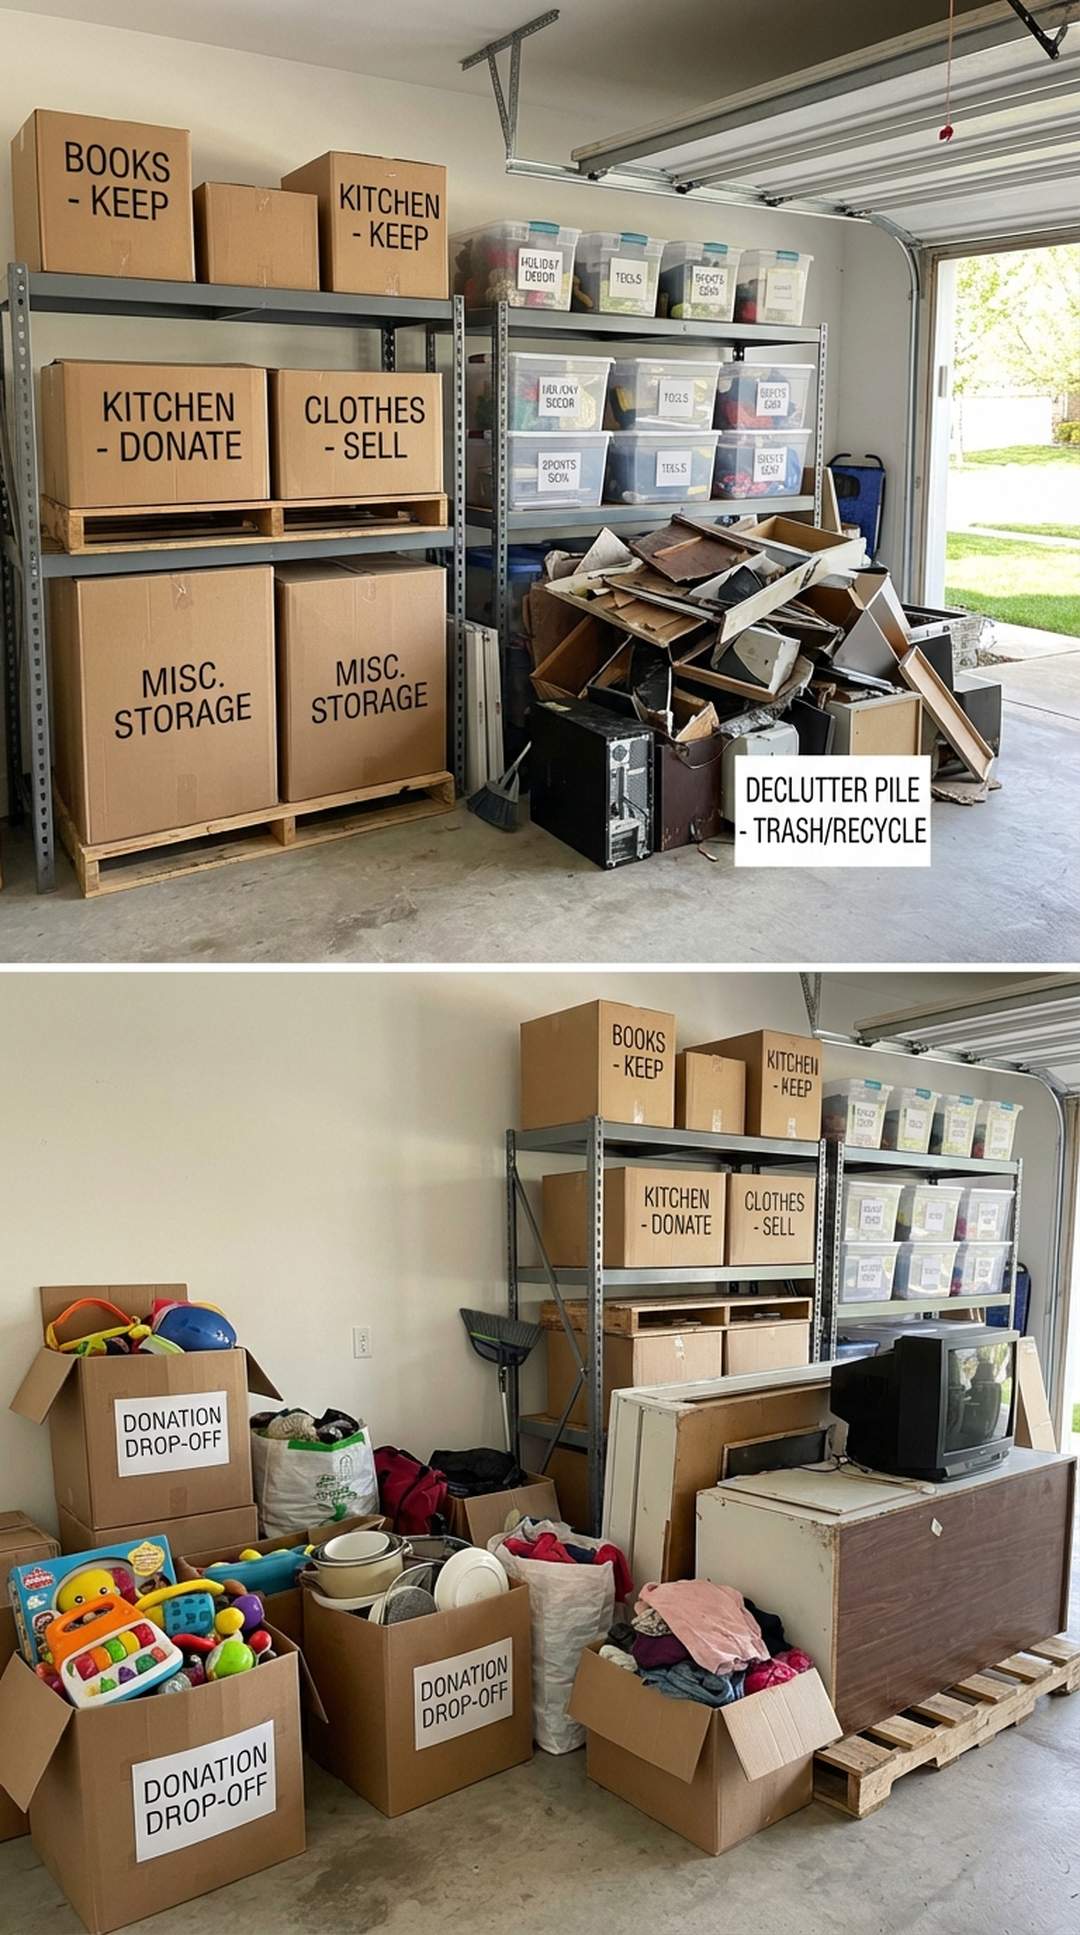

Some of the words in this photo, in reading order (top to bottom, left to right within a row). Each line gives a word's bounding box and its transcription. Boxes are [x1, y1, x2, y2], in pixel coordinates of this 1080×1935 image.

[64, 141, 170, 183] BOOKS
[91, 184, 169, 221] KEEP
[340, 183, 440, 220] KITCHEN
[370, 220, 429, 251] KEEP
[103, 391, 234, 423] KITCHEN
[305, 395, 425, 424] CLOTHES
[120, 430, 242, 462] DONATE
[344, 431, 408, 460] SELL
[142, 661, 224, 698] MISC.
[336, 653, 405, 687] MISC.
[114, 692, 252, 740] STORAGE
[311, 681, 429, 724] STORAGE
[612, 1023, 666, 1054] BOOKS
[624, 1054, 664, 1080] KEEP
[767, 1049, 819, 1077] KITCHEN
[781, 1077, 813, 1098] KEEP
[644, 1186, 710, 1209] KITCHEN
[745, 1190, 805, 1212] CLOTHES
[652, 1213, 712, 1235] DONATE
[763, 1216, 795, 1236] SELL
[123, 1406, 221, 1433] DONATION
[125, 1429, 221, 1458] DROP-OFF
[421, 1655, 508, 1702] DONATION
[422, 1679, 508, 1729] DROP-OFF
[144, 1742, 267, 1804] DONATION
[146, 1771, 267, 1836] DROP-OFF
